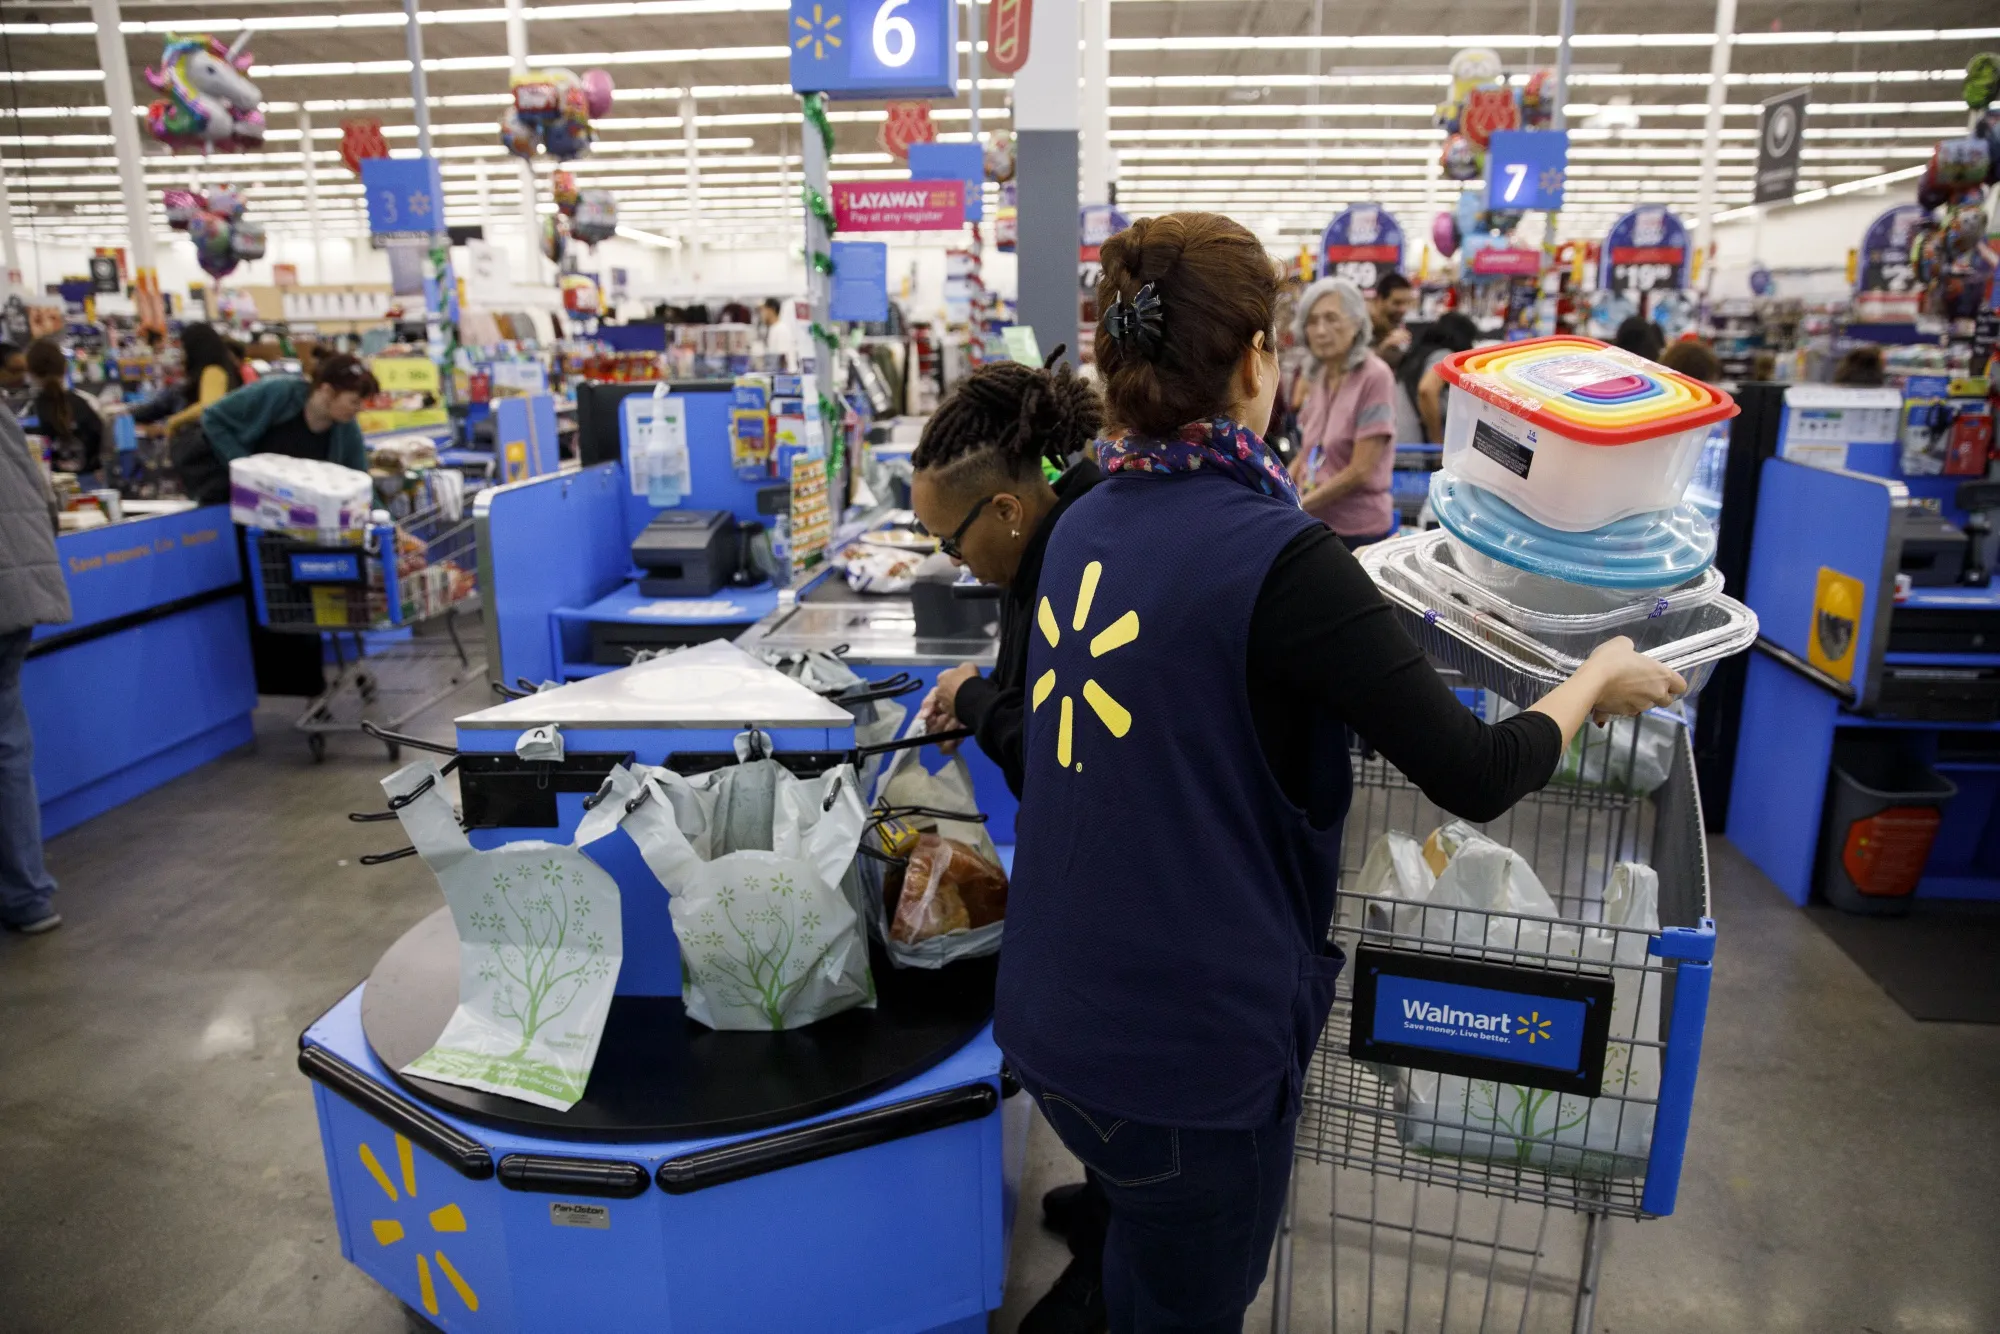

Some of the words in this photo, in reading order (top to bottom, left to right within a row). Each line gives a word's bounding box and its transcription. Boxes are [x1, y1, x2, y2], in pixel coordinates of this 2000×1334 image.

[872, 0, 916, 67] 6
[1504, 164, 1528, 202] 7
[382, 190, 398, 223] 3
[848, 191, 928, 209] LAYAWAY
[850, 211, 868, 224] Pay
[870, 211, 880, 222] at
[883, 213, 901, 224] any
[1528, 429, 1536, 438] 14
[1402, 999, 1512, 1034] Walmart
[1403, 1021, 1425, 1031] Save
[1425, 1025, 1459, 1036] money.
[1459, 1029, 1479, 1039] Live
[1479, 1032, 1511, 1044] better.
